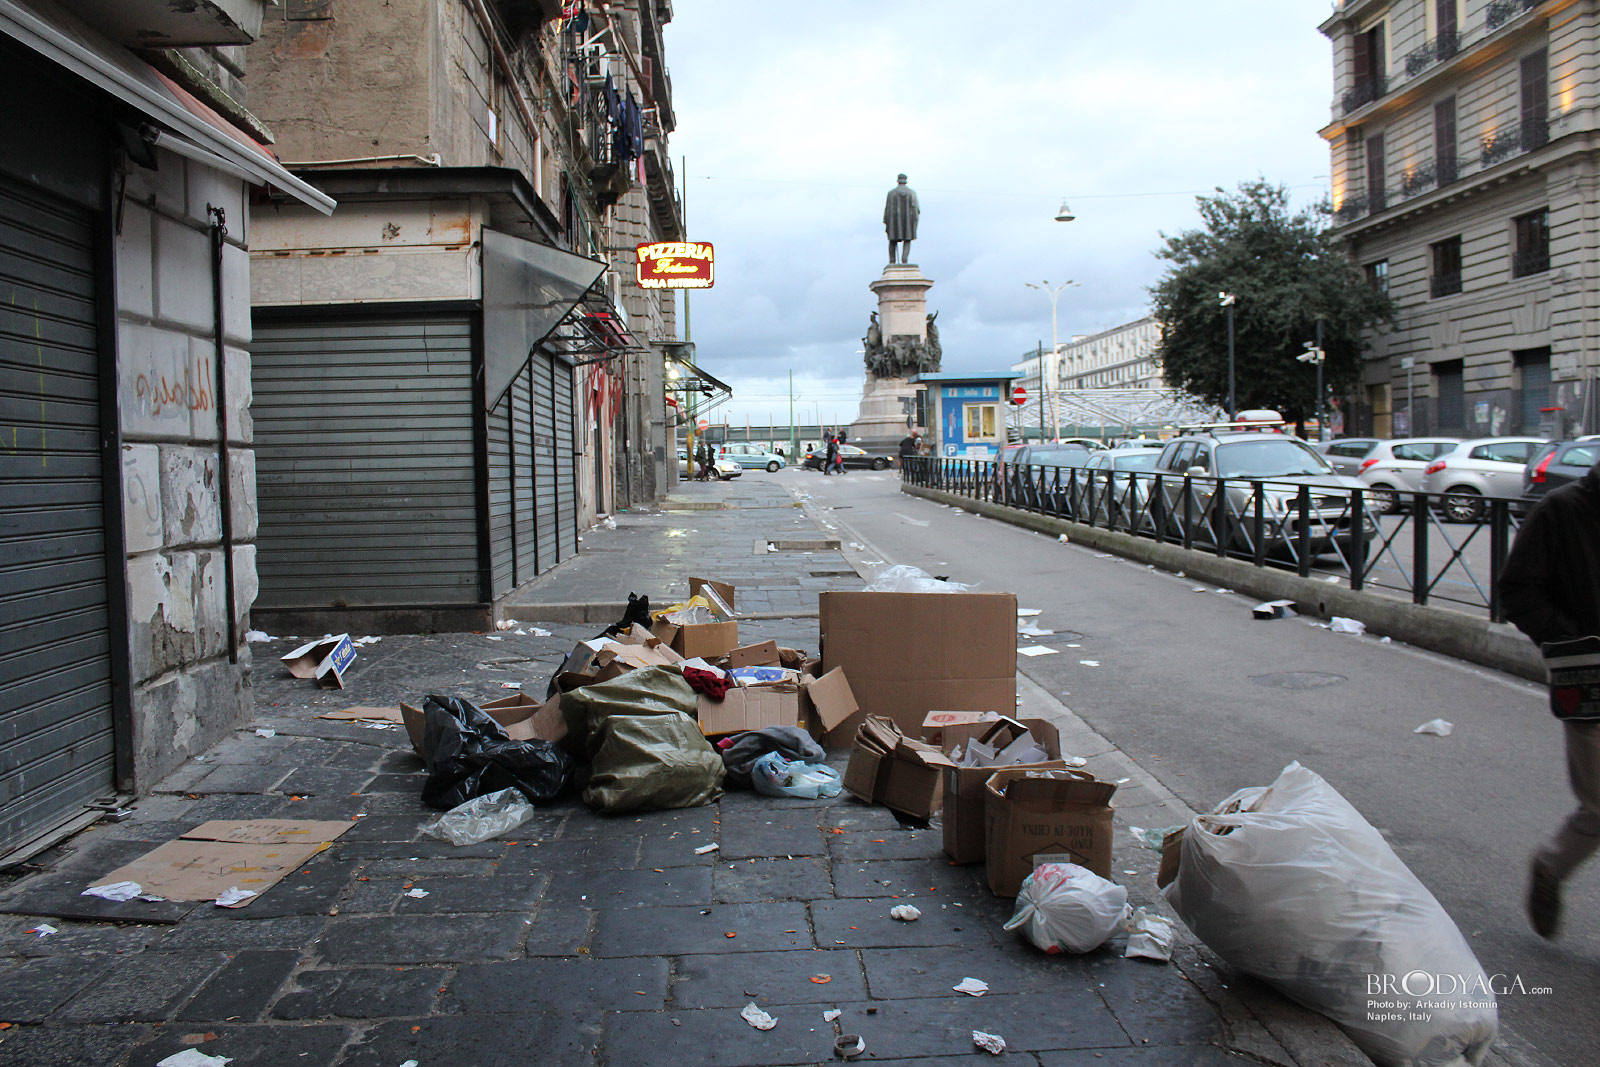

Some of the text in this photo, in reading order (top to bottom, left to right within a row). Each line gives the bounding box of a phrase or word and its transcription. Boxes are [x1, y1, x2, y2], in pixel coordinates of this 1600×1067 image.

[637, 242, 713, 262] PIZZERIA
[642, 278, 667, 288] SALA
[948, 446, 956, 456] P
[1023, 824, 1094, 837] MADE IN CHINA
